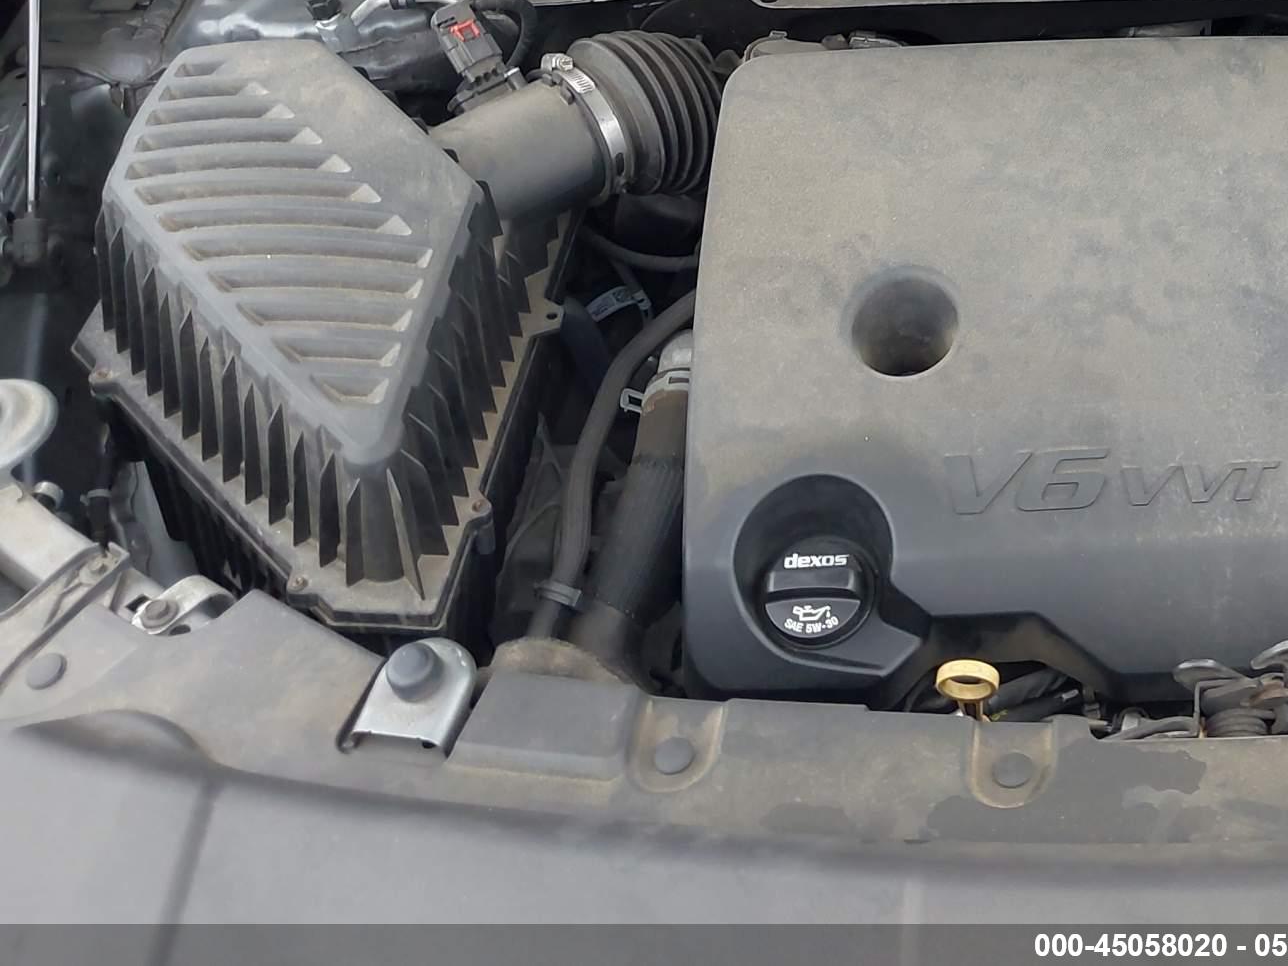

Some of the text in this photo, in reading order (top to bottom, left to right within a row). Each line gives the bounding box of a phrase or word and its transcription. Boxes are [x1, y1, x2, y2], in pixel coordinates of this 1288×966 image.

[944, 448, 1281, 515] V6 VVT
[783, 553, 850, 569] dexos
[784, 616, 839, 633] SAE 5W-30
